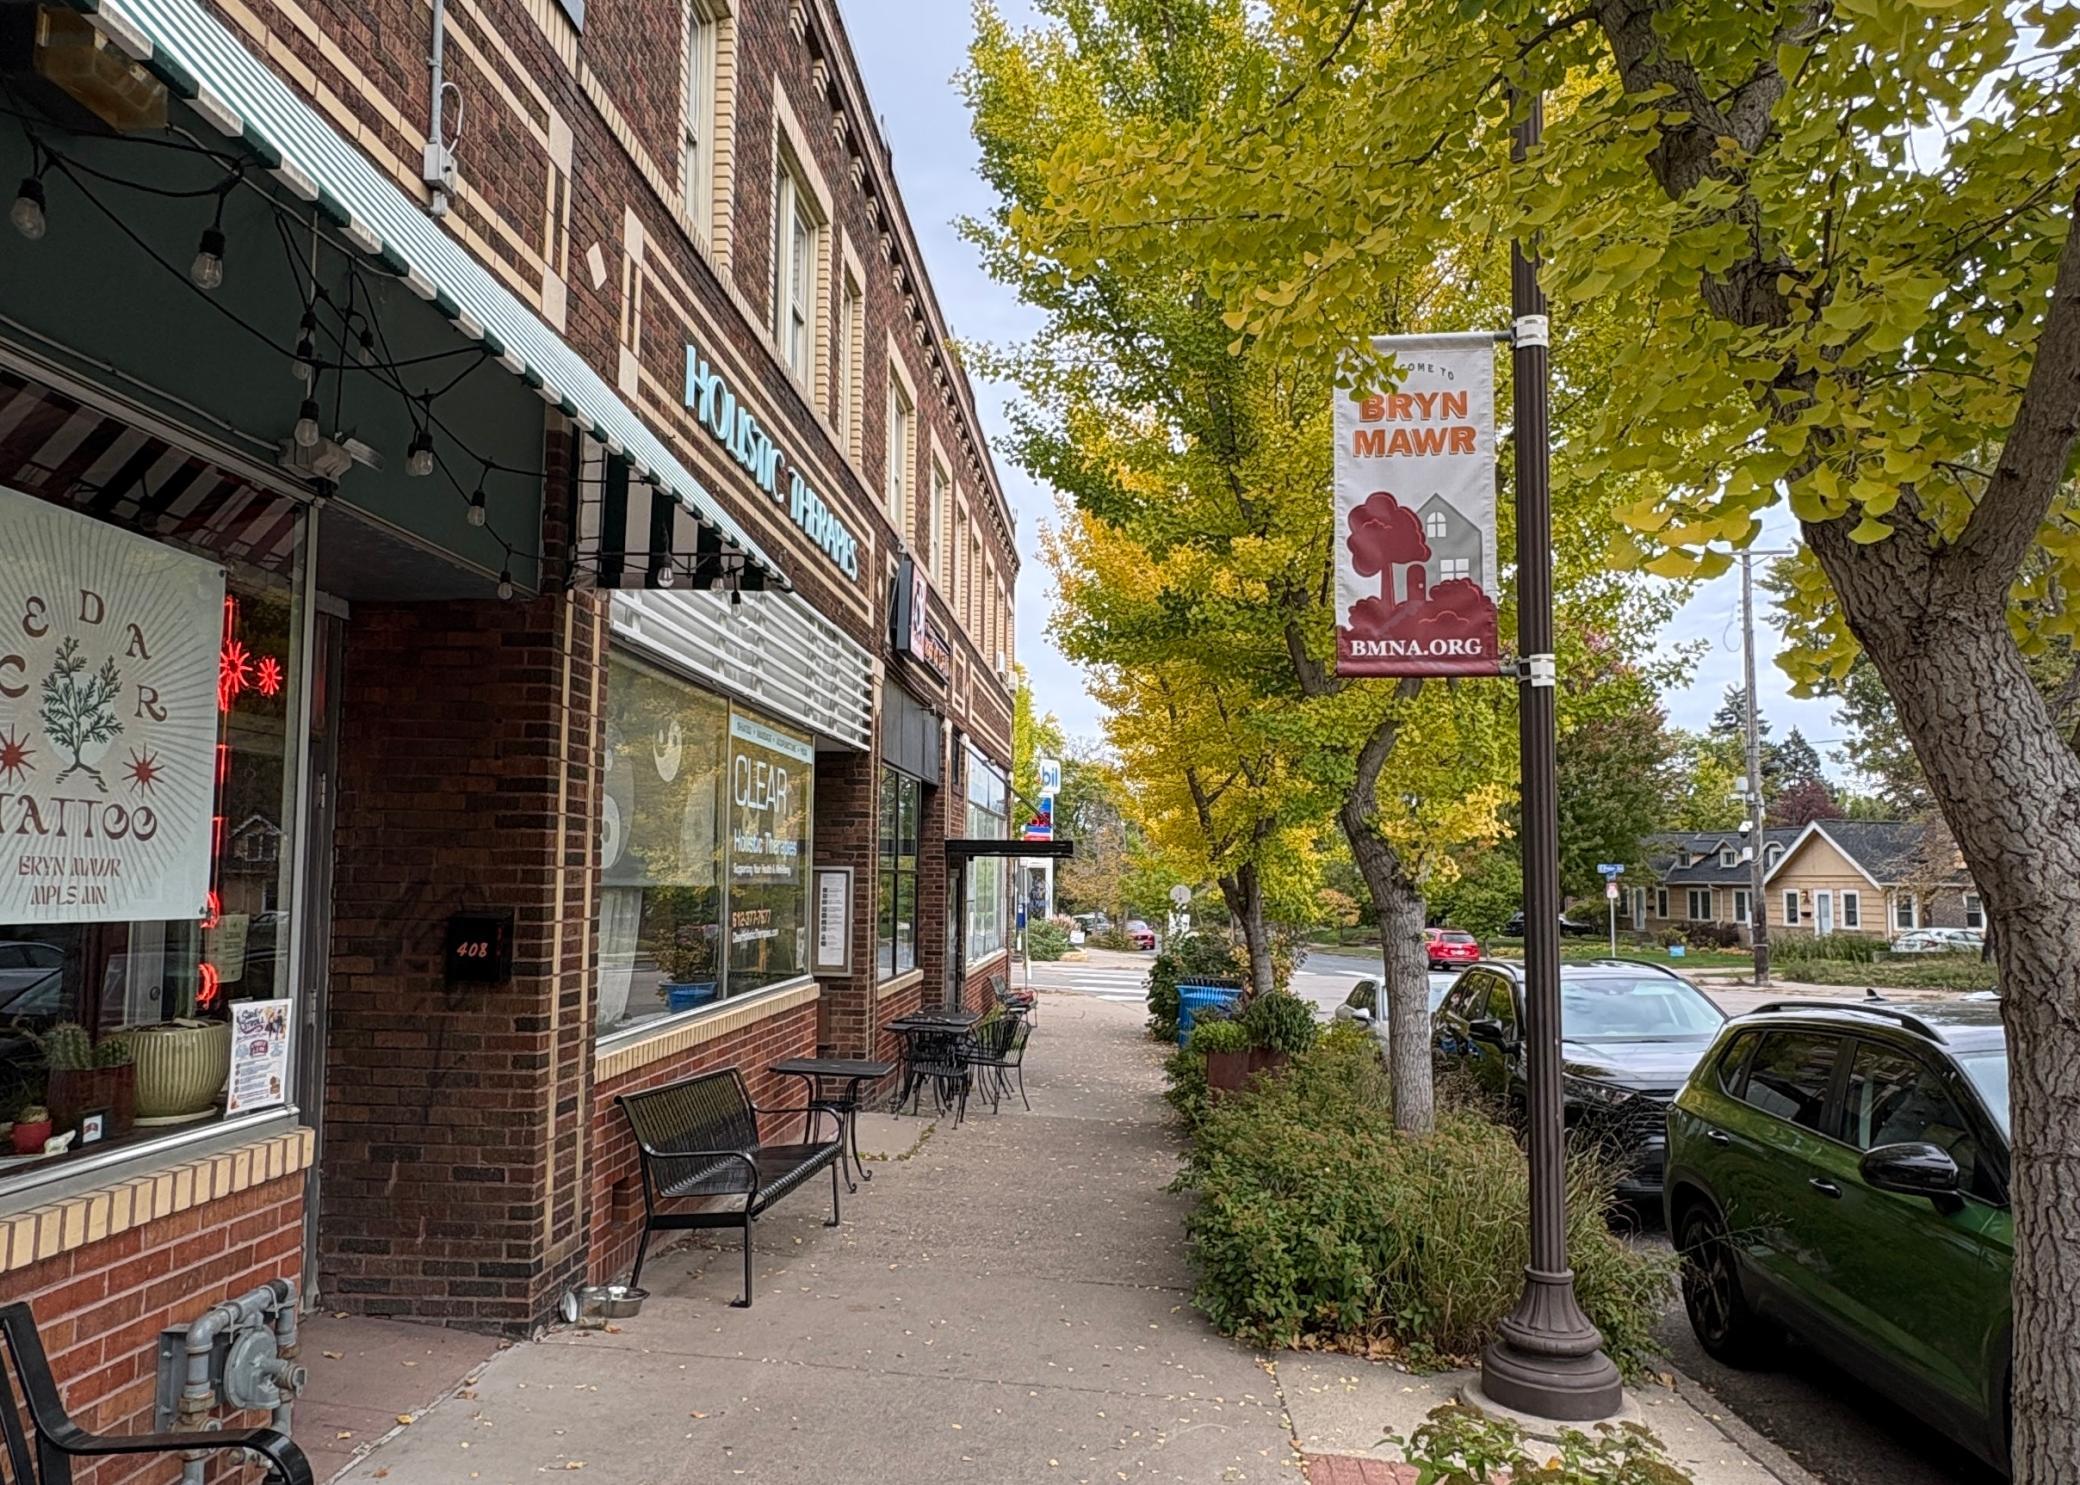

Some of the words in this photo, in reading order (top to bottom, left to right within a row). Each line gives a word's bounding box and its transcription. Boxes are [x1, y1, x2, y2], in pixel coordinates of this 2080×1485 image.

[1440, 367, 1455, 381] TO
[1359, 390, 1468, 422] BRYN
[1353, 426, 1477, 458] MAWR
[685, 344, 785, 503] HOLISTIC
[788, 466, 858, 582] THERAPIES
[0, 589, 168, 722] CEDAR
[1350, 637, 1483, 656] BMNA.ORG
[735, 754, 788, 815] CLEAR
[1042, 766, 1058, 787] bil
[0, 793, 158, 842] TATTOO
[18, 855, 67, 876] BRYN
[70, 857, 122, 878] MAWR
[456, 941, 489, 958] 408
